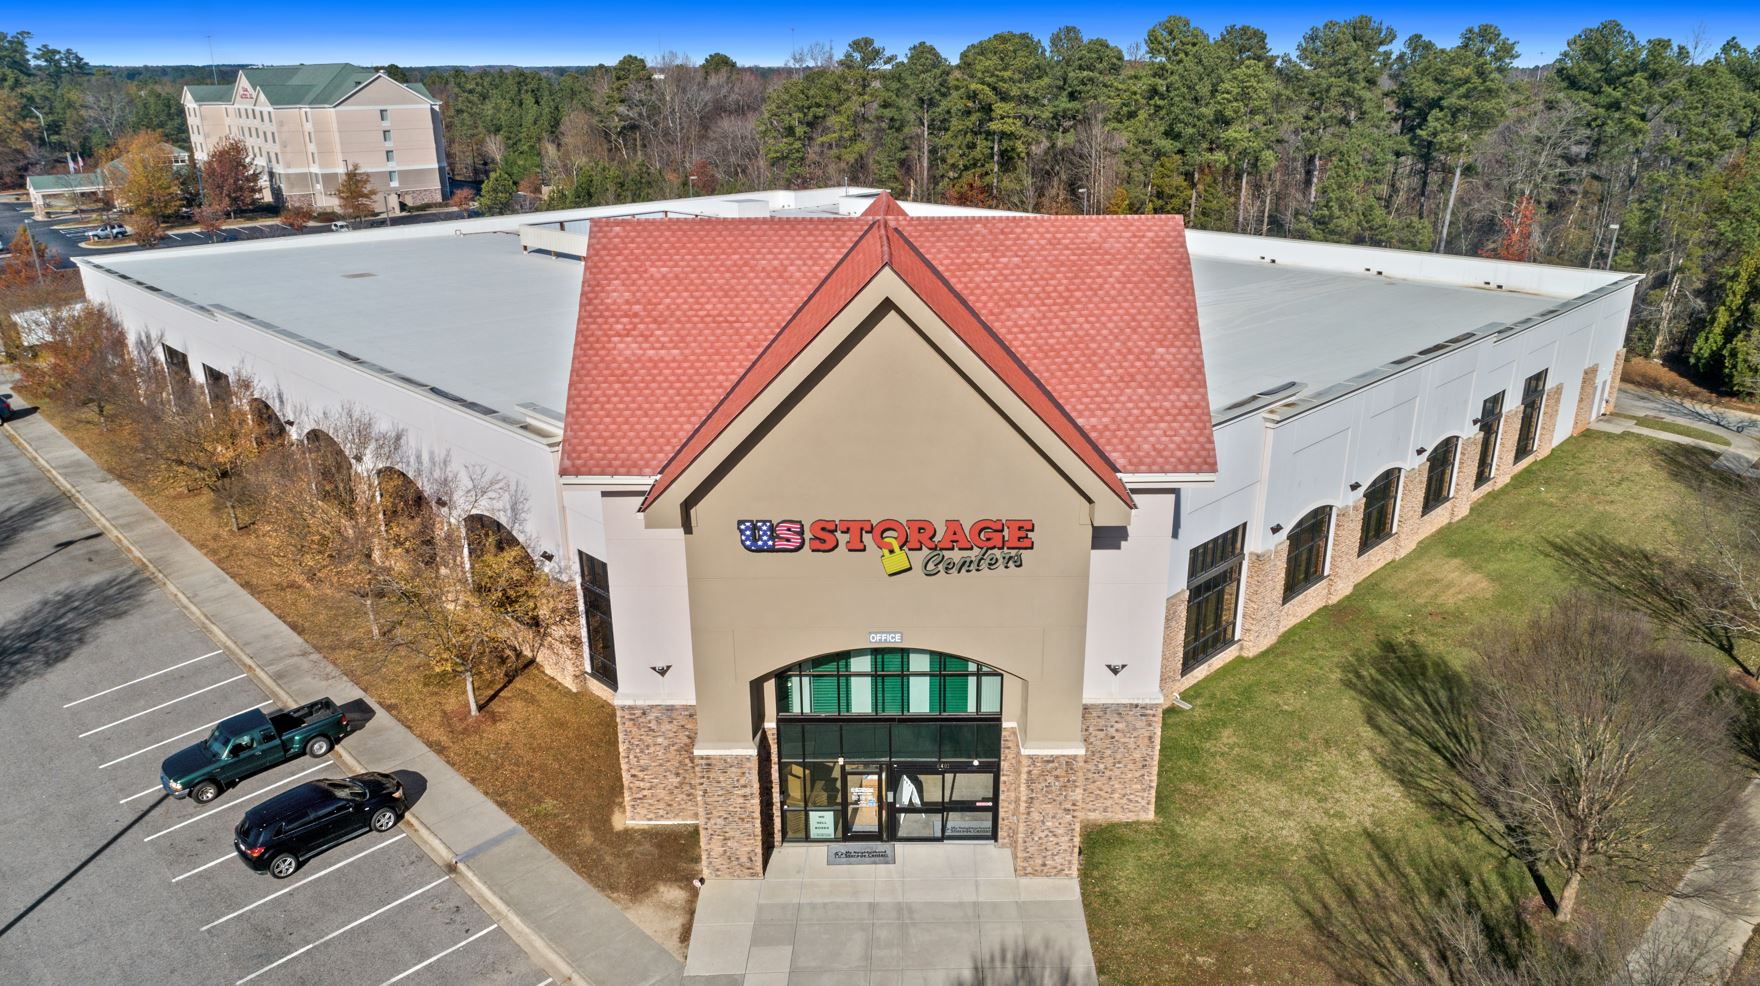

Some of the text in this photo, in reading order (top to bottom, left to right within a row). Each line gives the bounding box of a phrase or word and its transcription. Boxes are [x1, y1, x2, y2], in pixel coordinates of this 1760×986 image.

[737, 518, 1034, 552] US STORAGE
[921, 549, 1023, 576] Centers
[869, 633, 902, 643] OFFICE
